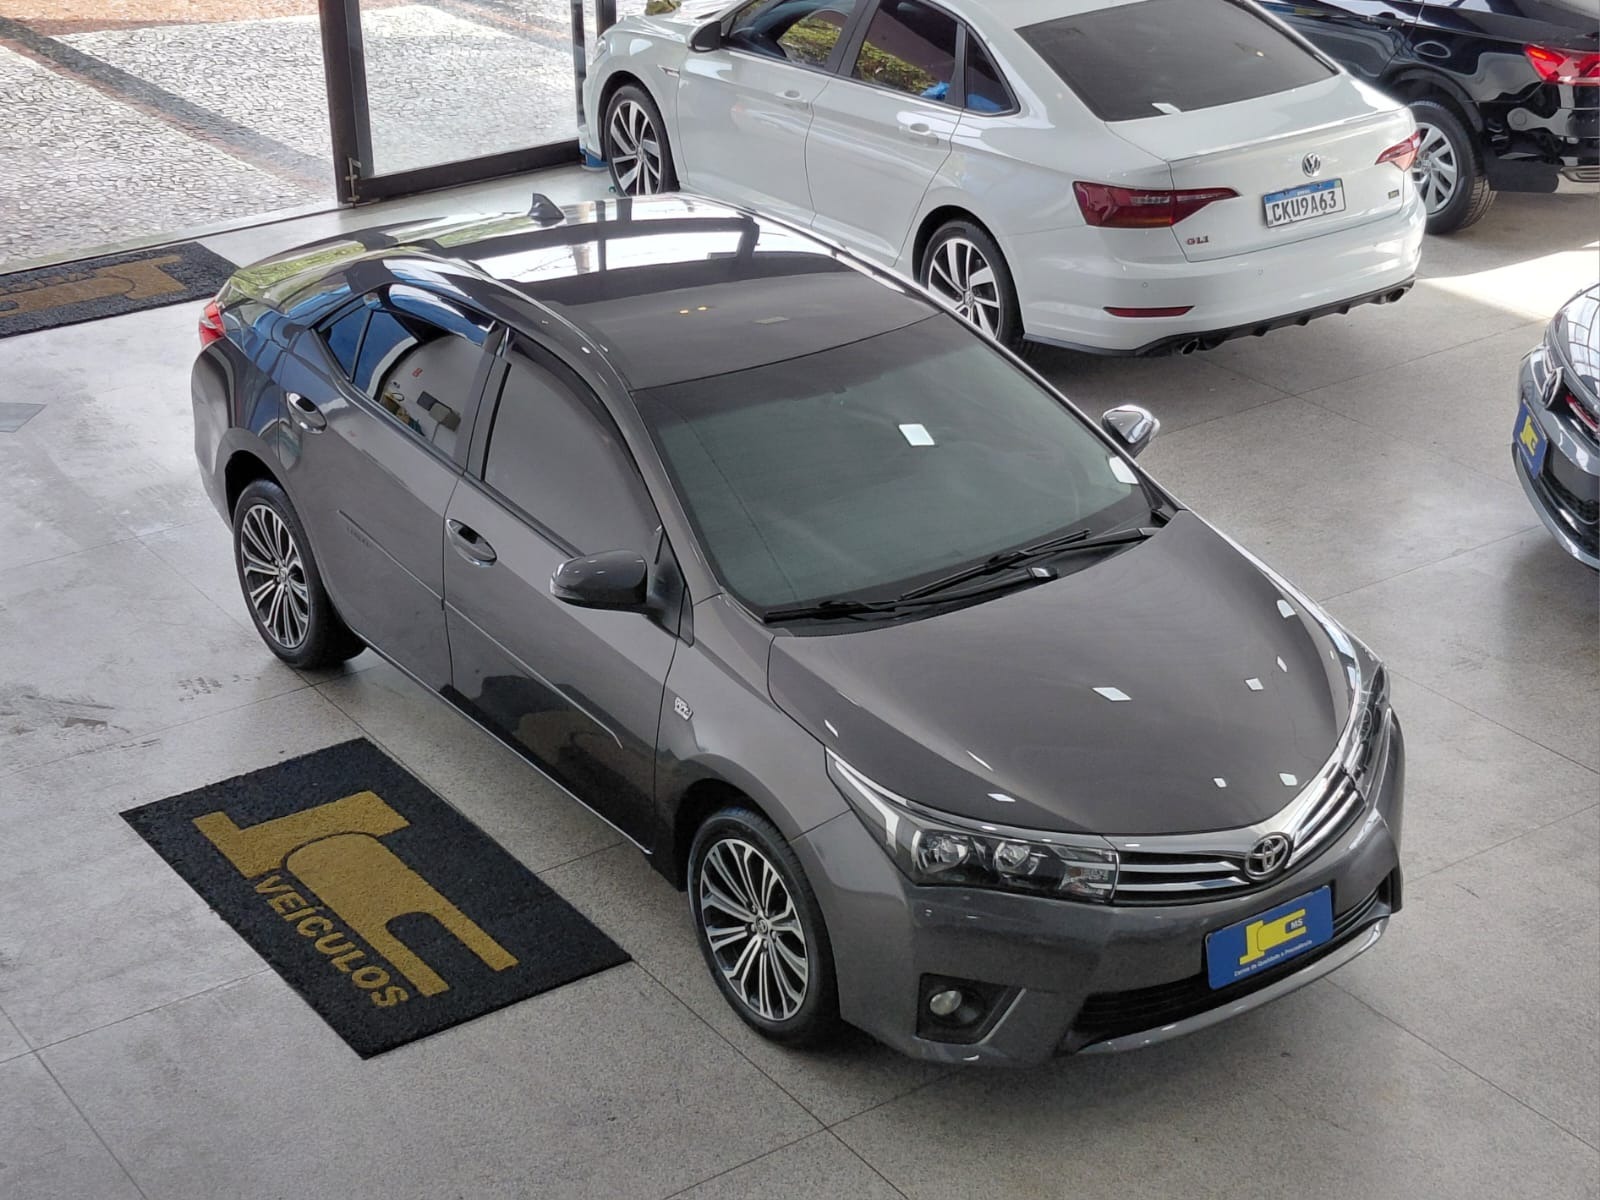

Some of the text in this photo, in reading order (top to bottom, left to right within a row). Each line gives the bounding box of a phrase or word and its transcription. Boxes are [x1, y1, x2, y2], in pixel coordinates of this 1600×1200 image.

[1272, 190, 1337, 222] CKU9A63
[1187, 235, 1209, 245] GLI
[1290, 918, 1303, 929] MS
